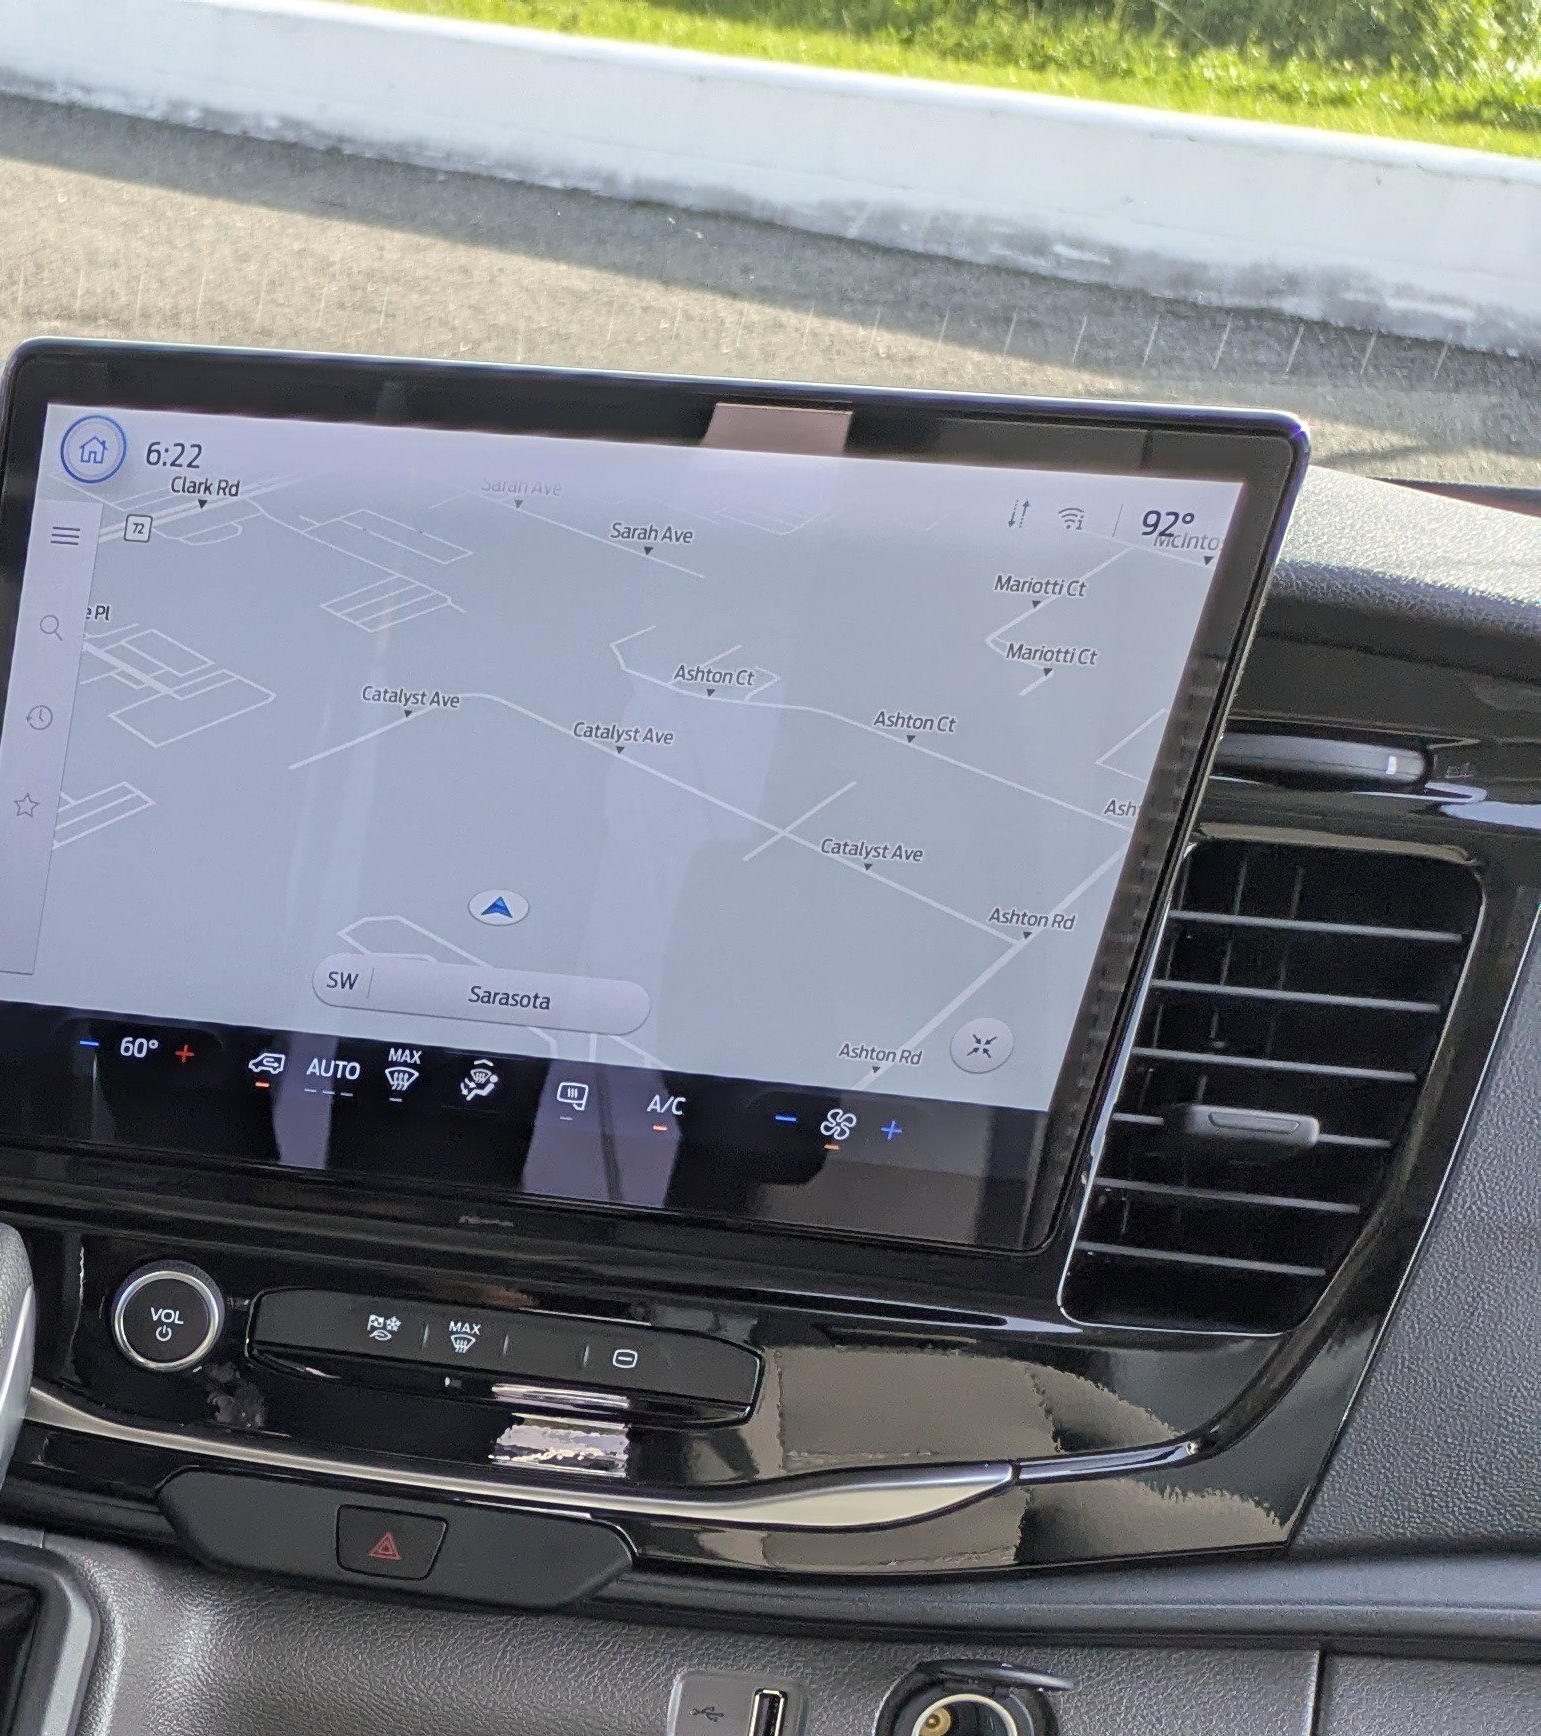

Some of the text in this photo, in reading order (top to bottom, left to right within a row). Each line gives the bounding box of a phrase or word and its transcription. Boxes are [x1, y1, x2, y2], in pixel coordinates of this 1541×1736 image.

[146, 442, 202, 468] 6:22
[171, 476, 240, 497] Clark Rd
[481, 478, 562, 496] Sarah Ave
[133, 523, 145, 534] 72
[610, 522, 693, 543] Sarah Ave
[1141, 510, 1194, 537] 92°
[994, 575, 1087, 597] Mariotti Ct
[1006, 643, 1098, 665] Mariotti Ct
[674, 664, 755, 686] Ashton Ct
[362, 686, 460, 708] Catalyst Ave
[873, 711, 956, 732] Ashton Ct
[573, 722, 674, 745] Catalyst Ave
[1104, 799, 1139, 817] Ash
[821, 838, 923, 862] Catalyst Ave
[988, 907, 1075, 930] Ashton Rd
[326, 971, 359, 990] SW
[468, 986, 551, 1011] Sarasota
[119, 1036, 158, 1060] 60°
[388, 1048, 422, 1065] MAX
[839, 1043, 922, 1065] Ashton Rd
[306, 1058, 361, 1080] AUTO
[647, 1095, 686, 1115] A/C
[150, 1307, 184, 1324] VOL
[448, 1320, 481, 1335] MAX
